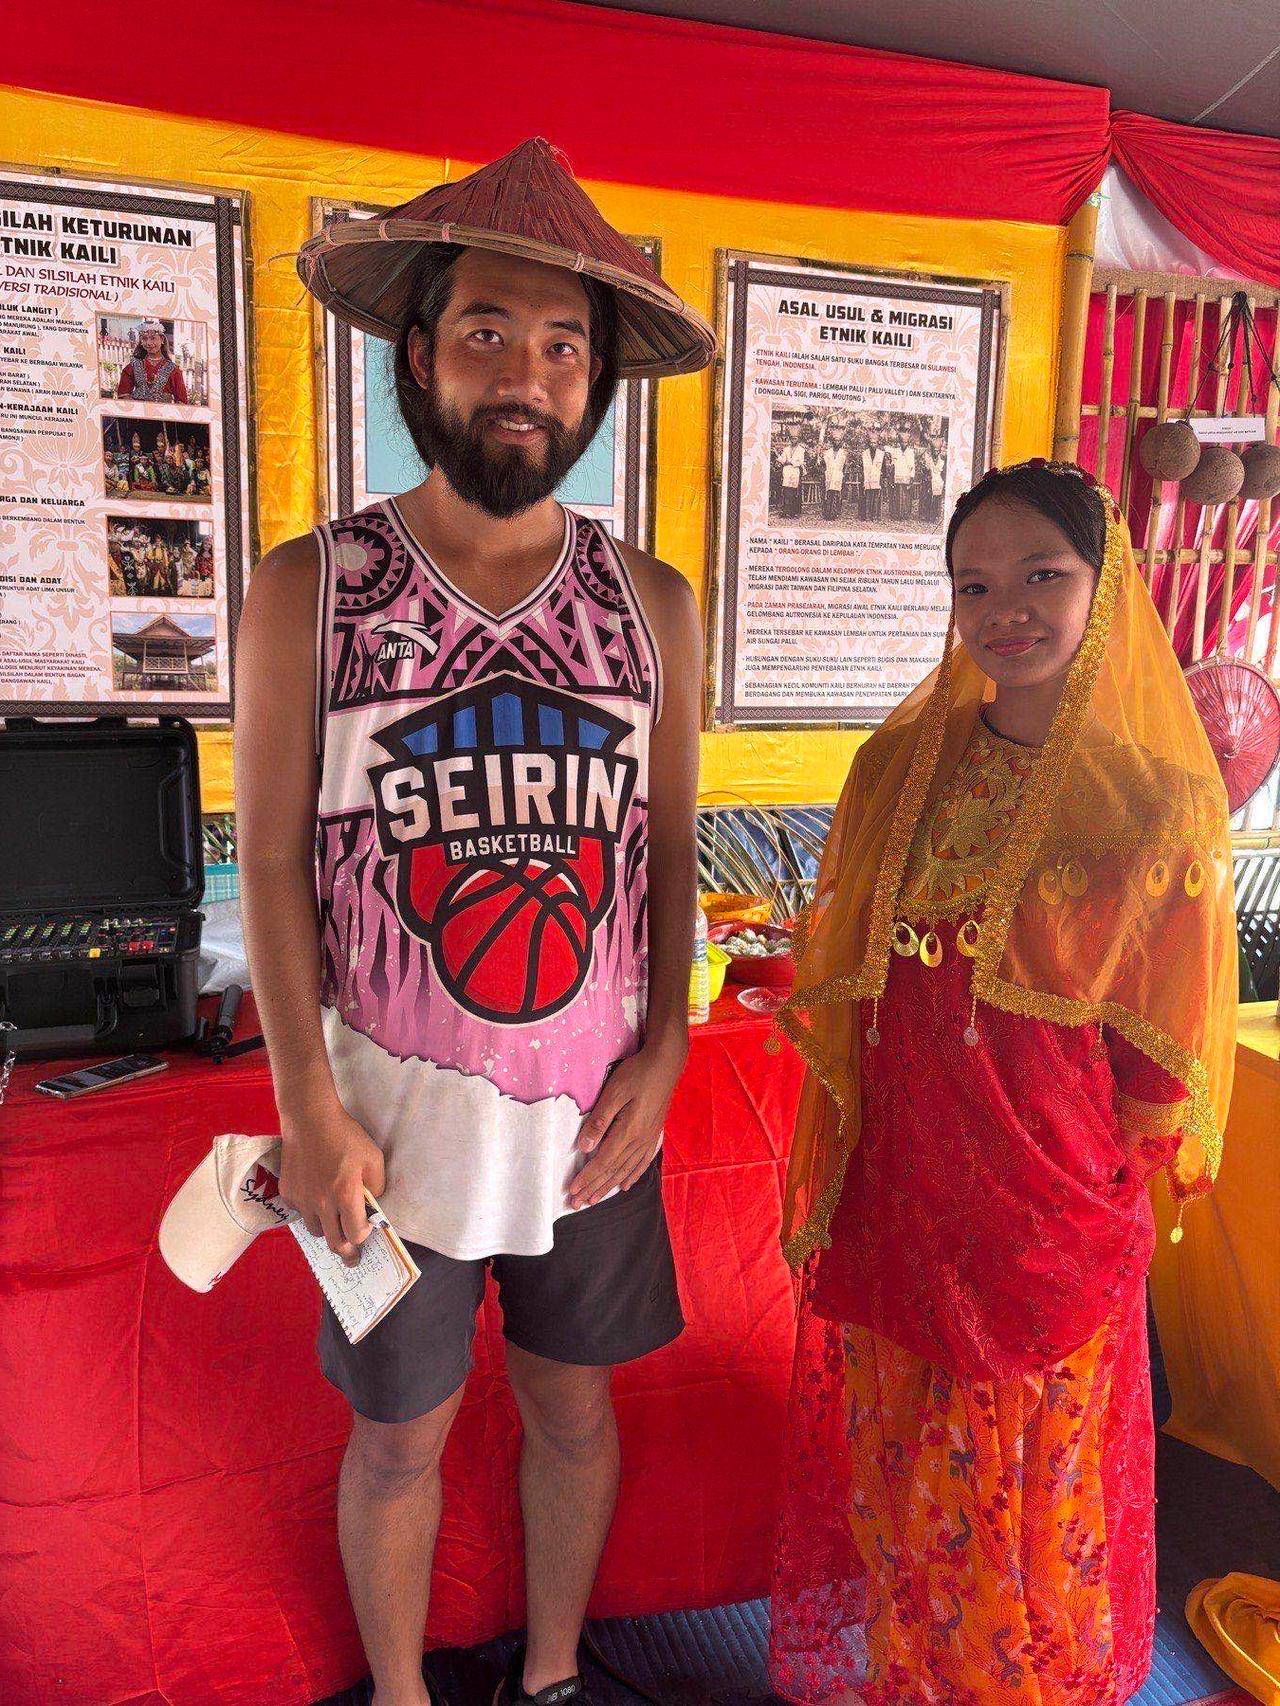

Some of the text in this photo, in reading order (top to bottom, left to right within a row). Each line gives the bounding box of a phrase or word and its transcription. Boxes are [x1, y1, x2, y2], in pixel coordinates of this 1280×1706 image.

[0, 209, 192, 247] ILAH KETURUNAN
[60, 242, 117, 265] KAILI
[5, 265, 175, 293] DAN SILSILAH ETNIK KAILI
[34, 284, 112, 301] TRADISIONAL
[21, 305, 52, 315] LANGIT
[778, 299, 953, 330] ASAL USUL & MIGRASI
[819, 325, 912, 348] ETNIK KAILI
[4, 347, 26, 355] KAILI
[756, 348, 774, 357] ETNIK
[775, 350, 791, 358] KAILI
[811, 353, 830, 362] SALAH
[831, 355, 846, 363] SATU
[865, 358, 889, 367] BANGSA
[890, 360, 919, 369] TERBESAR
[755, 378, 784, 387] KAWASAN
[786, 380, 818, 389] TERUTAMA
[822, 383, 848, 391] LEMBAH
[849, 385, 864, 393] PALU
[868, 386, 883, 394] PALU
[884, 388, 905, 396] VALLEY
[909, 390, 922, 398] DAN
[56, 407, 79, 416] KAILI
[20, 496, 85, 507] DAN KELUARGA
[749, 537, 768, 545] NAMA
[794, 539, 821, 547] BERASAL
[822, 540, 852, 548] DARIPADA
[868, 541, 897, 549] TEMPATAN
[749, 546, 773, 554] KEPADA
[748, 565, 774, 573] MEREKA
[833, 567, 864, 575] KELOMPOK
[20, 576, 37, 584] DAN
[747, 583, 774, 591] MIGRASI
[747, 601, 763, 609] PADA
[827, 603, 852, 611] MIGRASI
[377, 641, 413, 662] ANTA
[381, 753, 628, 843] SEIRIN
[450, 833, 576, 861] BASKETBALL
